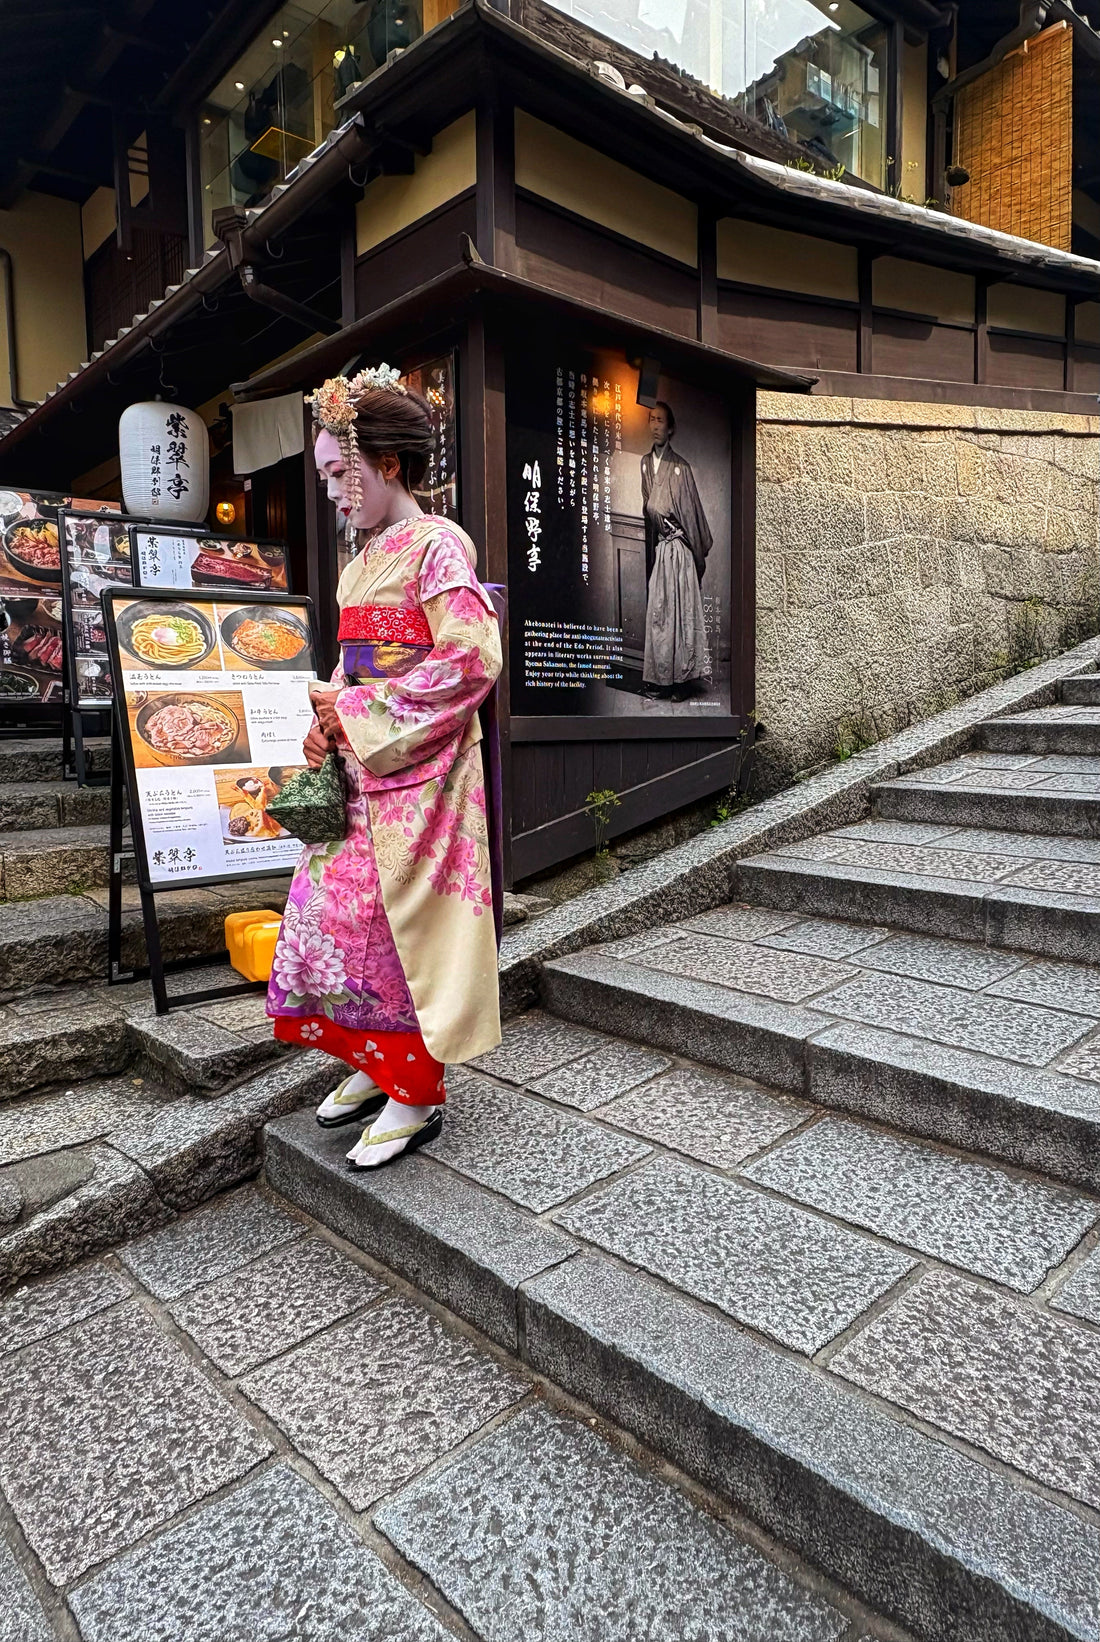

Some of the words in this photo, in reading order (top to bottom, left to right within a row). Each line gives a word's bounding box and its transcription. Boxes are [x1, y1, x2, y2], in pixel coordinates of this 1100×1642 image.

[166, 412, 190, 499] 紫翠亭
[522, 460, 542, 572] 明保野亭
[152, 847, 196, 866] 紫翠亭
